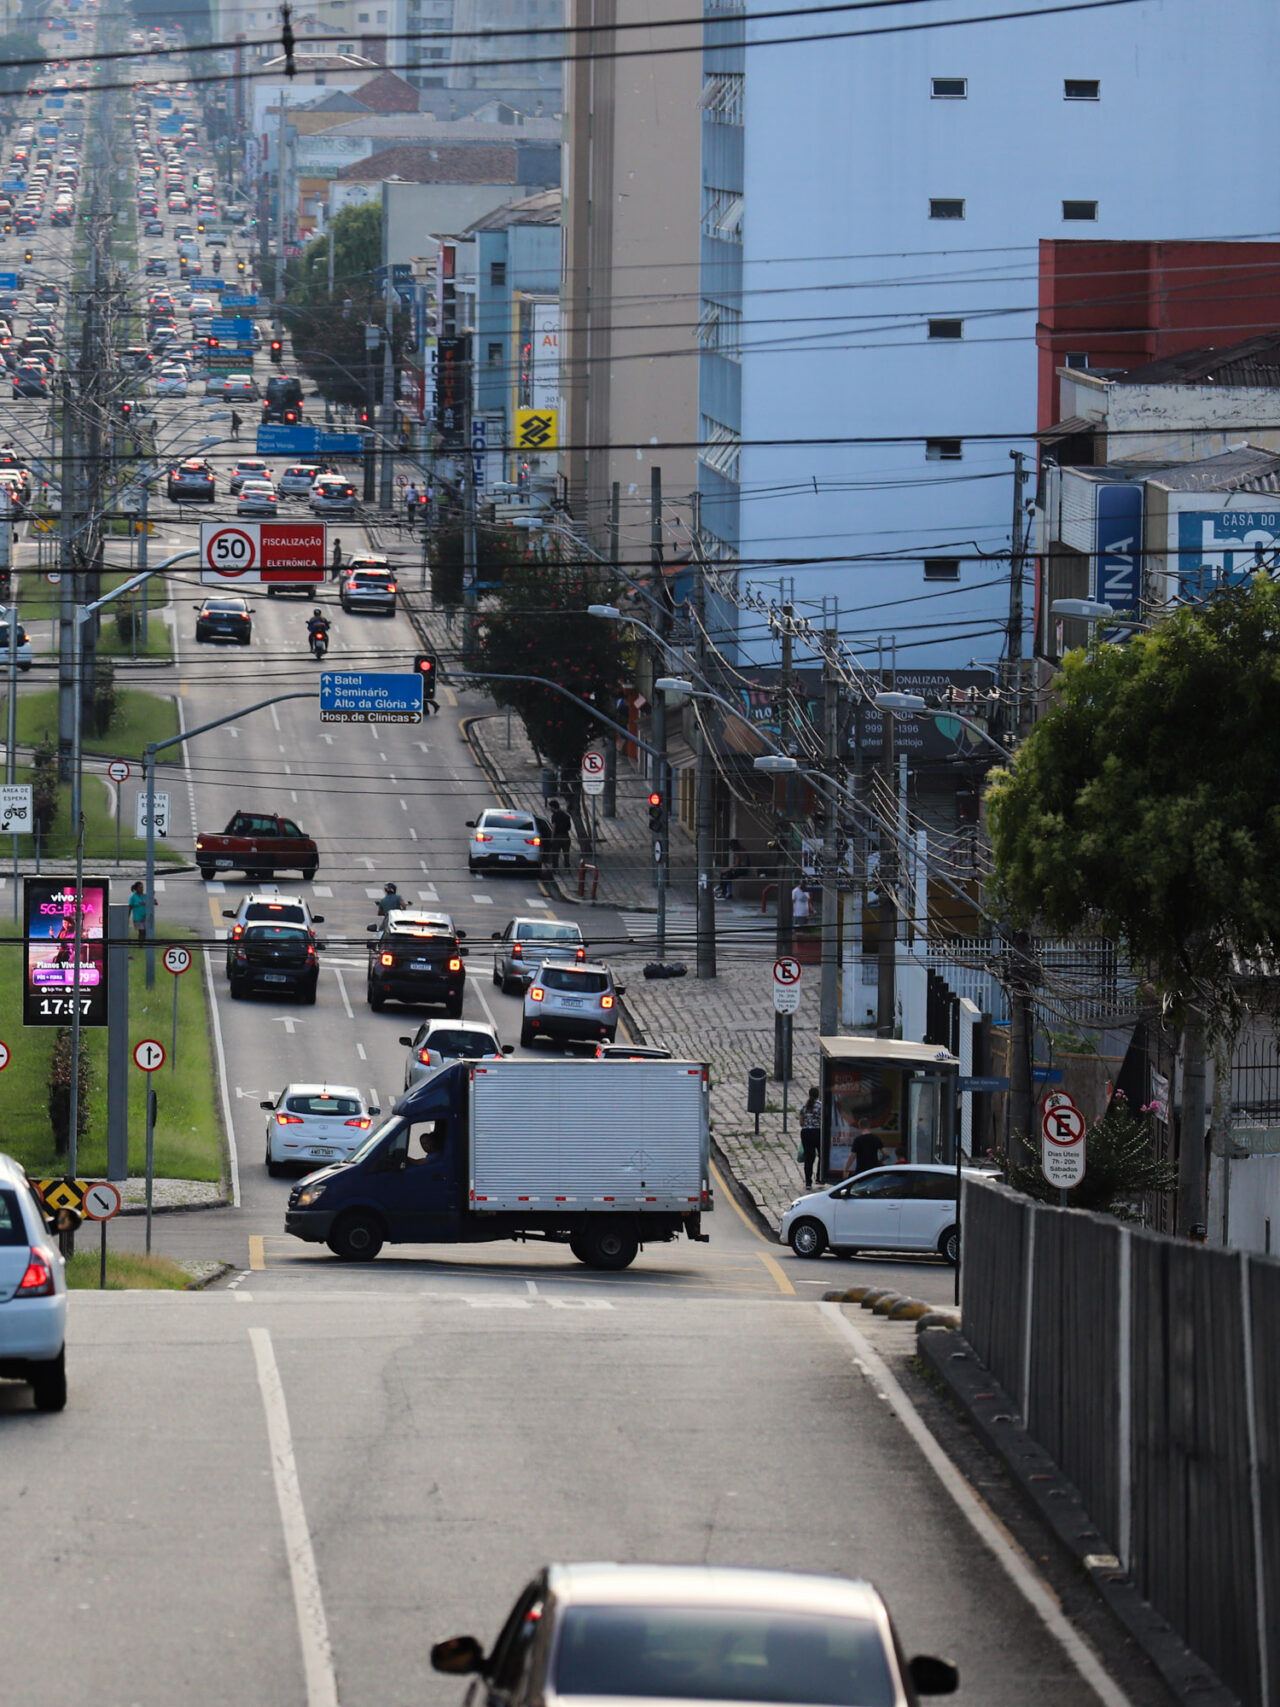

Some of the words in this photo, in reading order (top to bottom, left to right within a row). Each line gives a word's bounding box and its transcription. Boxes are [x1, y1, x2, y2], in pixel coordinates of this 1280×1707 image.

[1223, 514, 1254, 526] CASA
[1261, 514, 1276, 526] DO
[262, 537, 322, 547] FISCALIZAÇÃO
[217, 538, 245, 559] 50
[266, 558, 317, 567] ELETRÔNICA
[334, 675, 362, 685] Batel
[334, 687, 389, 697] Seminário
[334, 699, 355, 708] Alto
[358, 699, 372, 708] da
[375, 699, 407, 709] Glória
[865, 725, 918, 733] 999-1396
[51, 892, 74, 902] vivo
[168, 951, 187, 965] 50
[40, 999, 92, 1015] 17:57
